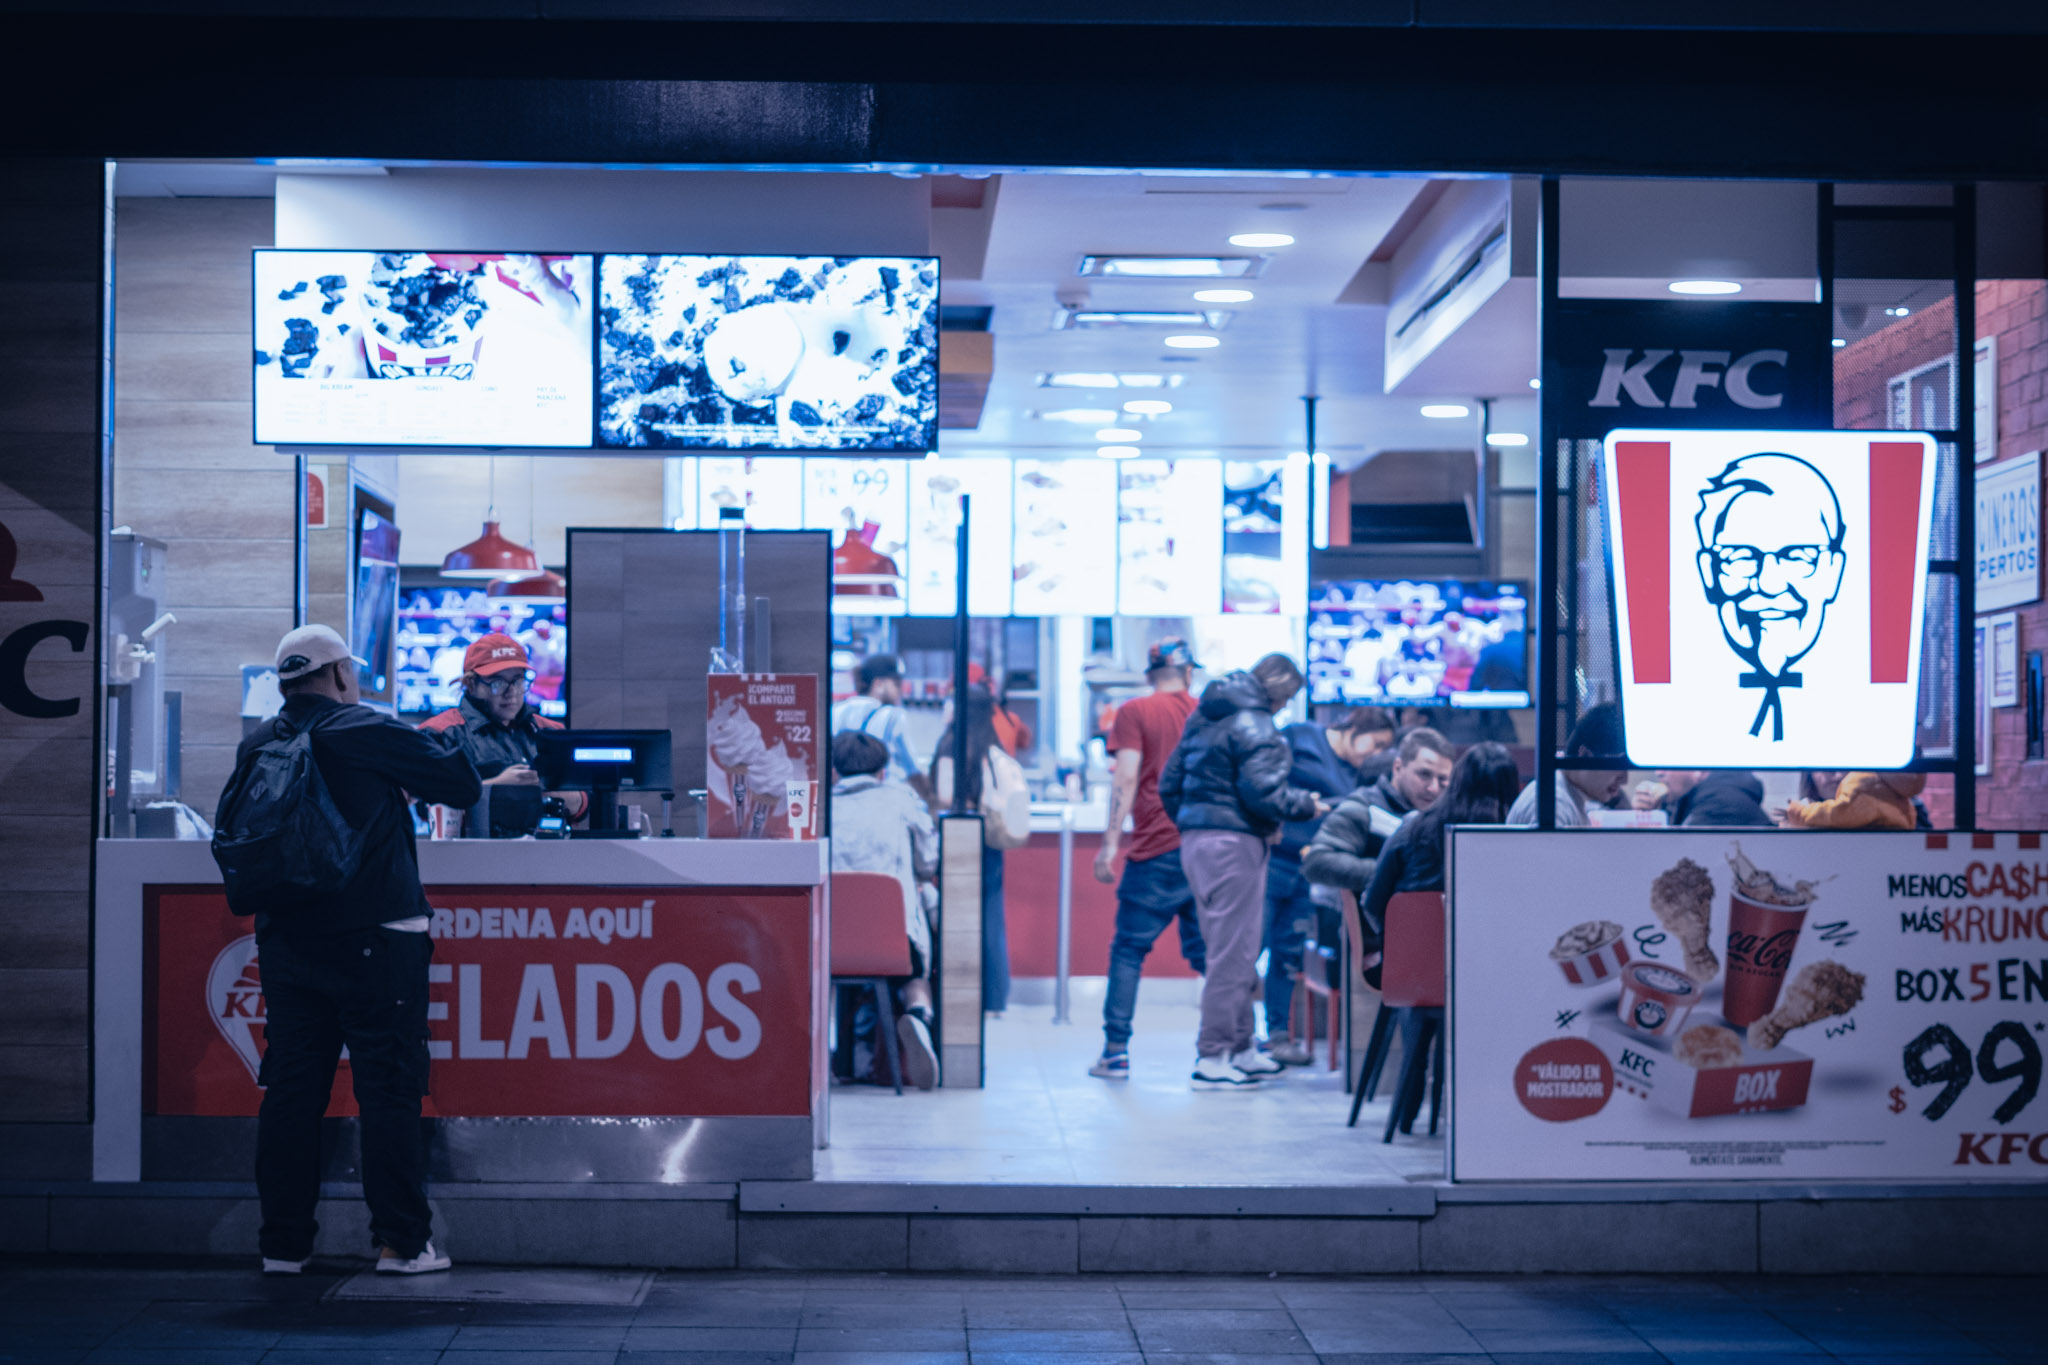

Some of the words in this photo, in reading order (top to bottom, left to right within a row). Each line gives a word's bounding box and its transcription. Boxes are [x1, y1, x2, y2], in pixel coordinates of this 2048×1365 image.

[1587, 348, 1788, 410] KFC
[1977, 484, 2036, 553] CINEROS
[1977, 546, 2036, 582] PERTOS
[492, 646, 516, 659] KFC
[1887, 873, 1967, 899] MENOS
[429, 907, 557, 939] RDENA
[562, 900, 656, 946] AQUÍ
[1901, 905, 1945, 934] MÁS
[1896, 968, 1965, 1003] BOX
[1969, 962, 1991, 1004] 5
[427, 962, 762, 1061] ELADOS
[1619, 1047, 1655, 1078] KFC
[1526, 1081, 1605, 1099] MOSTRADOR
[1733, 1069, 1782, 1105] BOX
